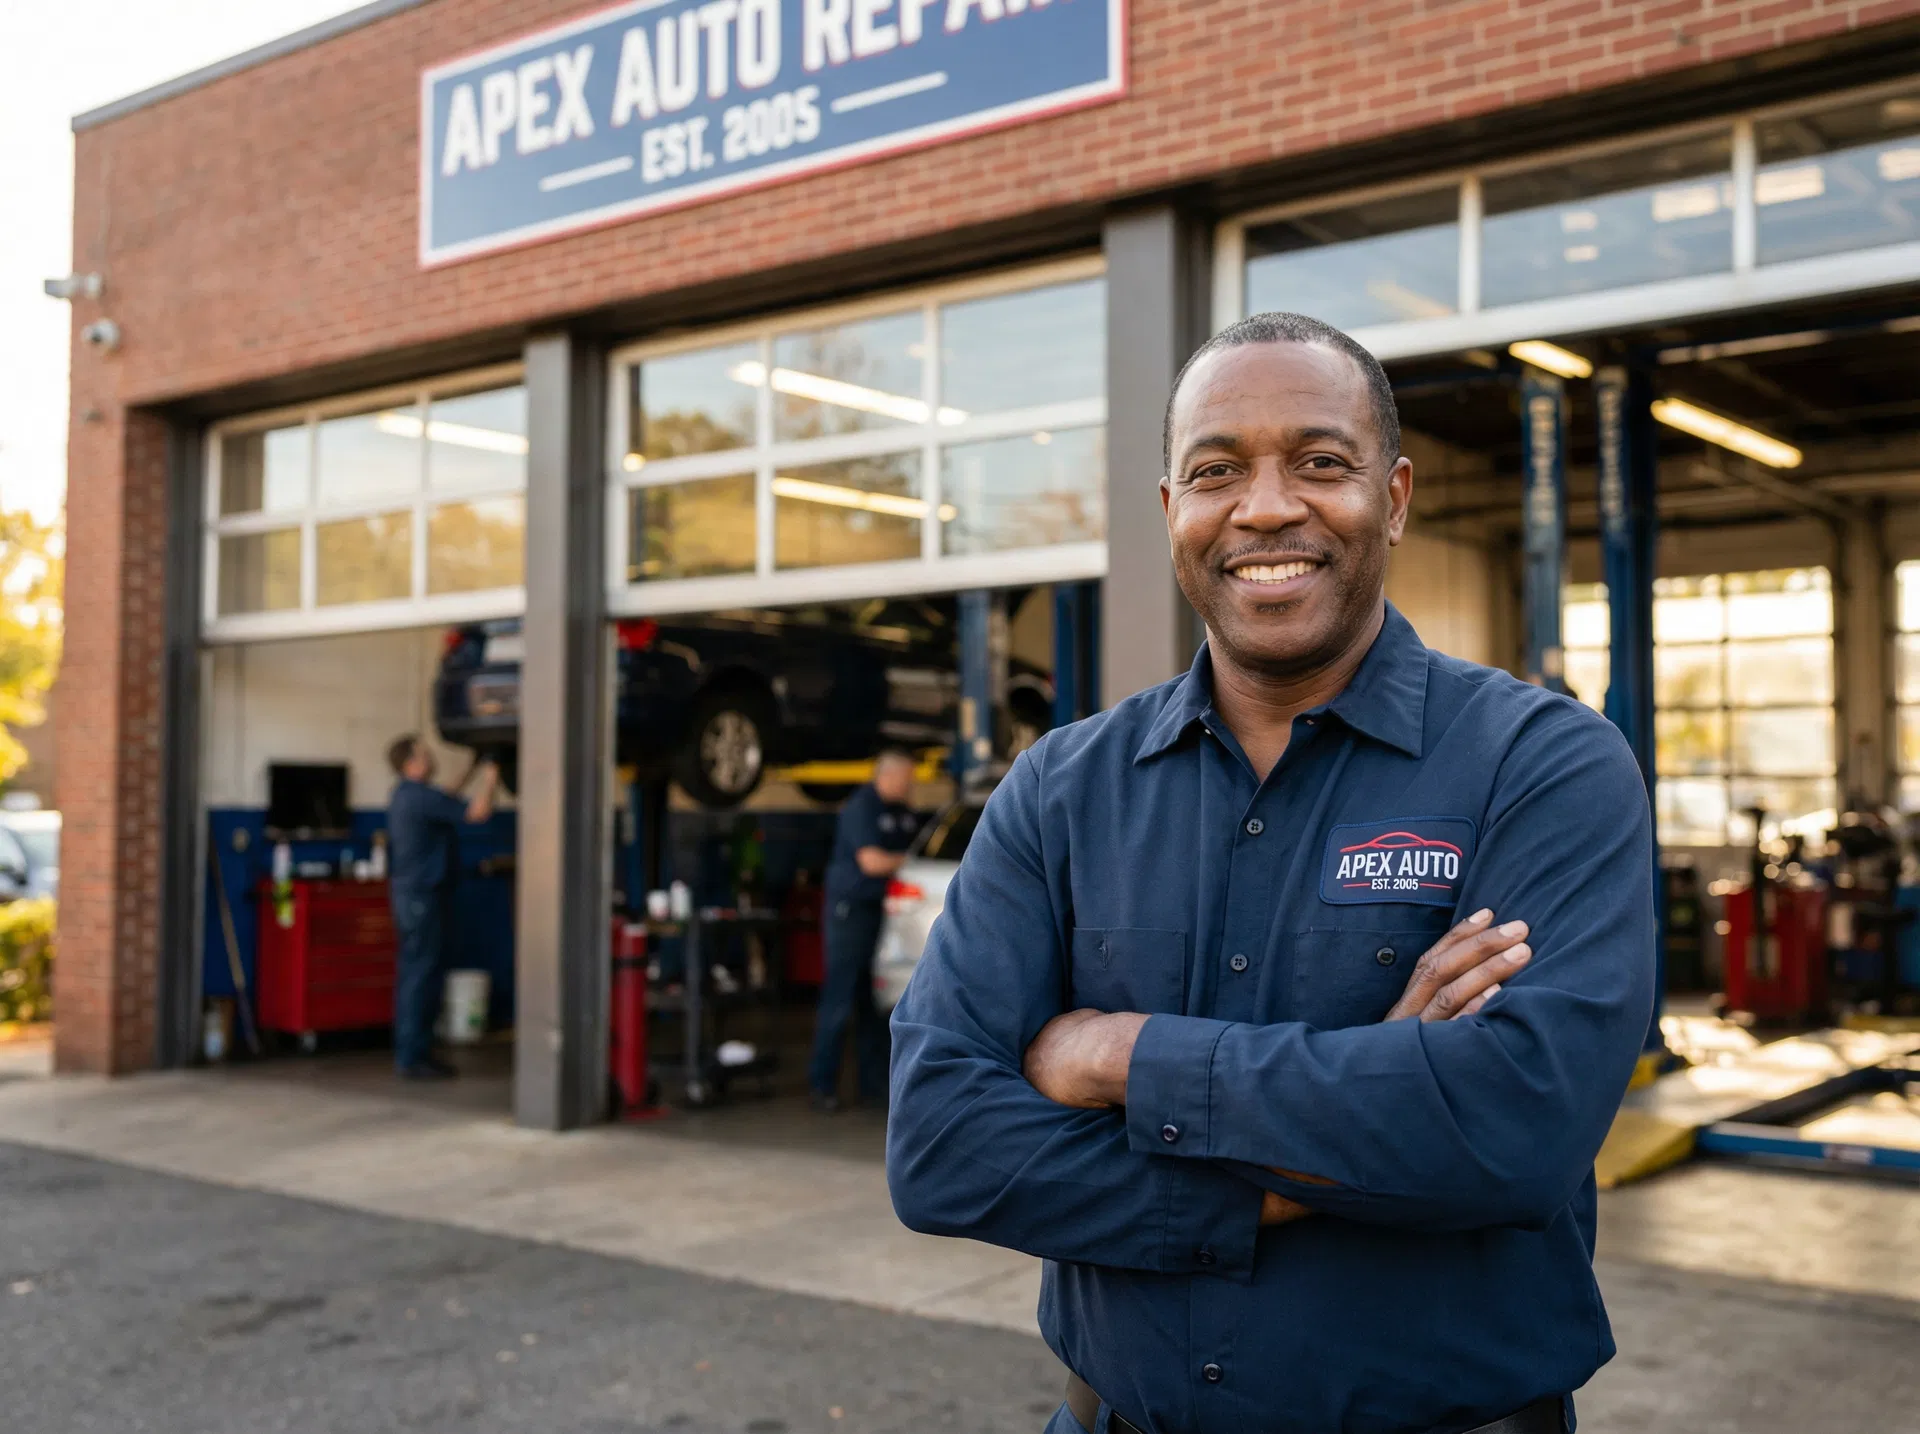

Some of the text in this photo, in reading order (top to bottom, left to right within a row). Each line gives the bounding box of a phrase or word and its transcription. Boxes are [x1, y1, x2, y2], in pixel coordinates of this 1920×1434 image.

[441, 43, 595, 177] APEX
[610, 0, 782, 127] AUTO
[641, 84, 821, 183] EST. 2005
[1336, 850, 1459, 880] APEX AUTO
[1371, 878, 1419, 891] EST. 2005
